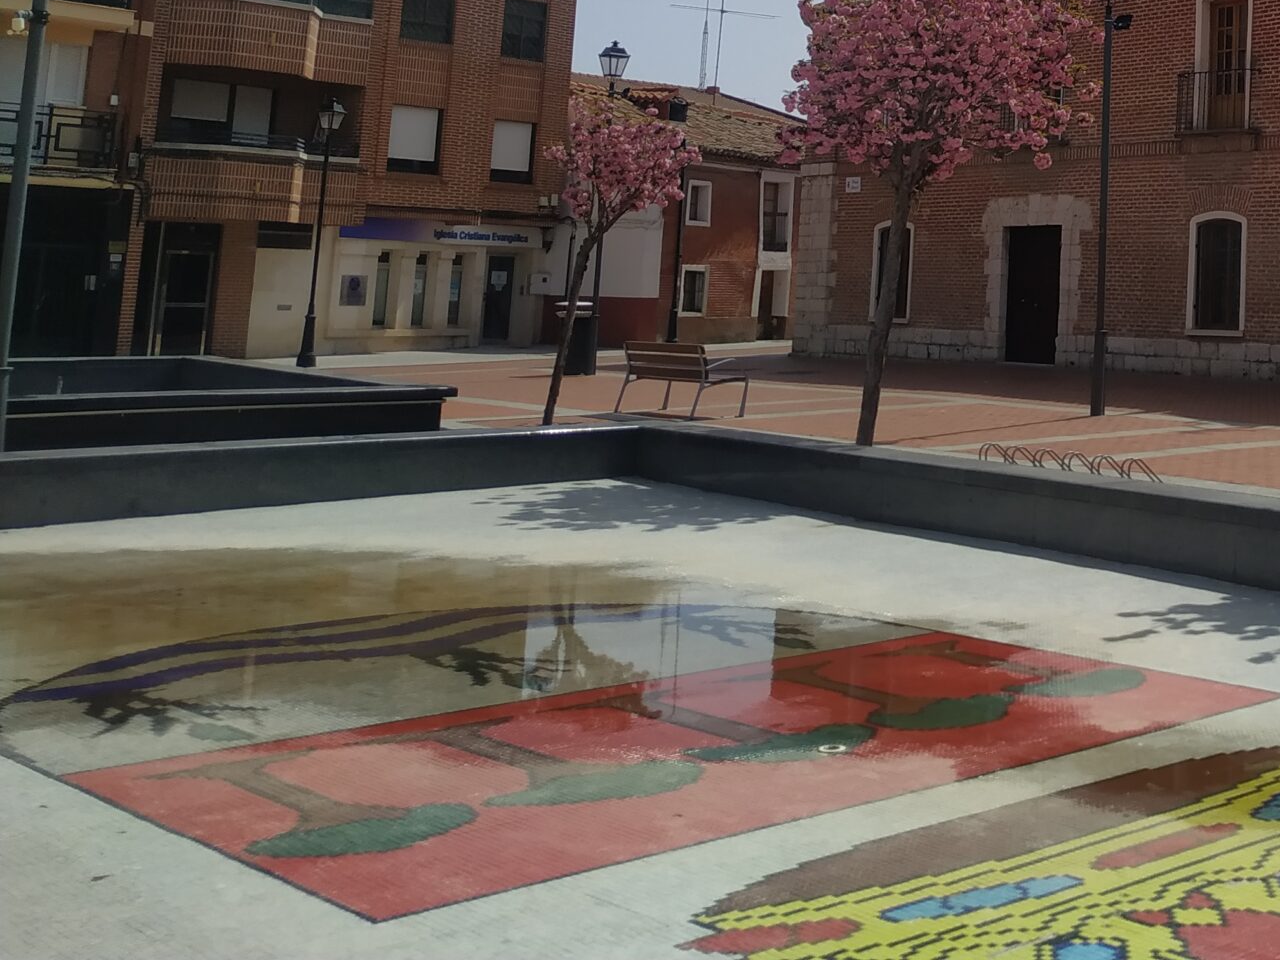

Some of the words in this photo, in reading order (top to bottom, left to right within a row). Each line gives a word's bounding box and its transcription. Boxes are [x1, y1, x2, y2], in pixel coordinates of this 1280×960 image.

[434, 229, 458, 240] Iglesia
[459, 231, 490, 241] Cristiana
[492, 232, 528, 244] Evangélica
